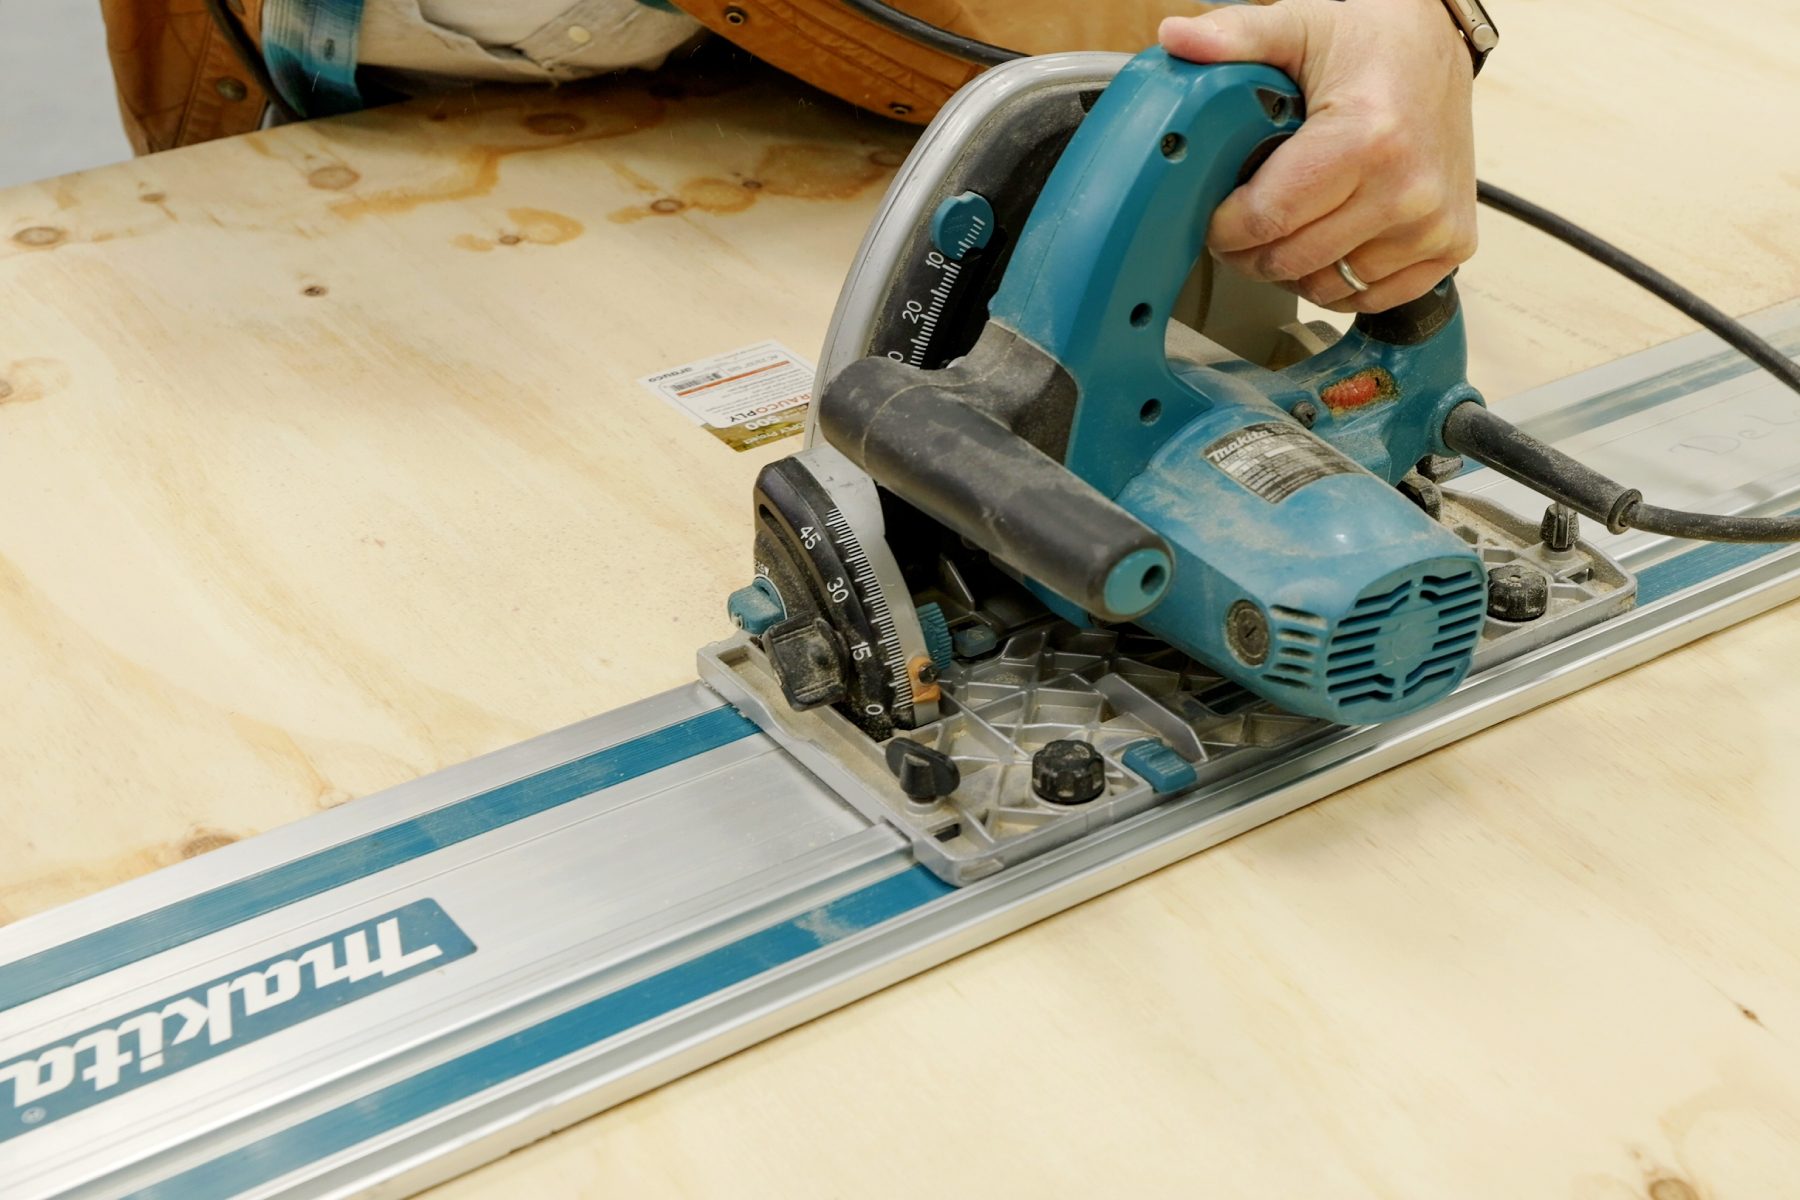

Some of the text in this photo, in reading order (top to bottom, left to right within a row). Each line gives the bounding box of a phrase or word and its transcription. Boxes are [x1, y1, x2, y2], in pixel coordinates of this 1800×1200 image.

[926, 251, 945, 269] 10
[902, 300, 922, 324] 20
[800, 526, 822, 550] 45
[827, 577, 849, 603] 30
[851, 641, 873, 661] 15
[865, 704, 884, 715] 0
